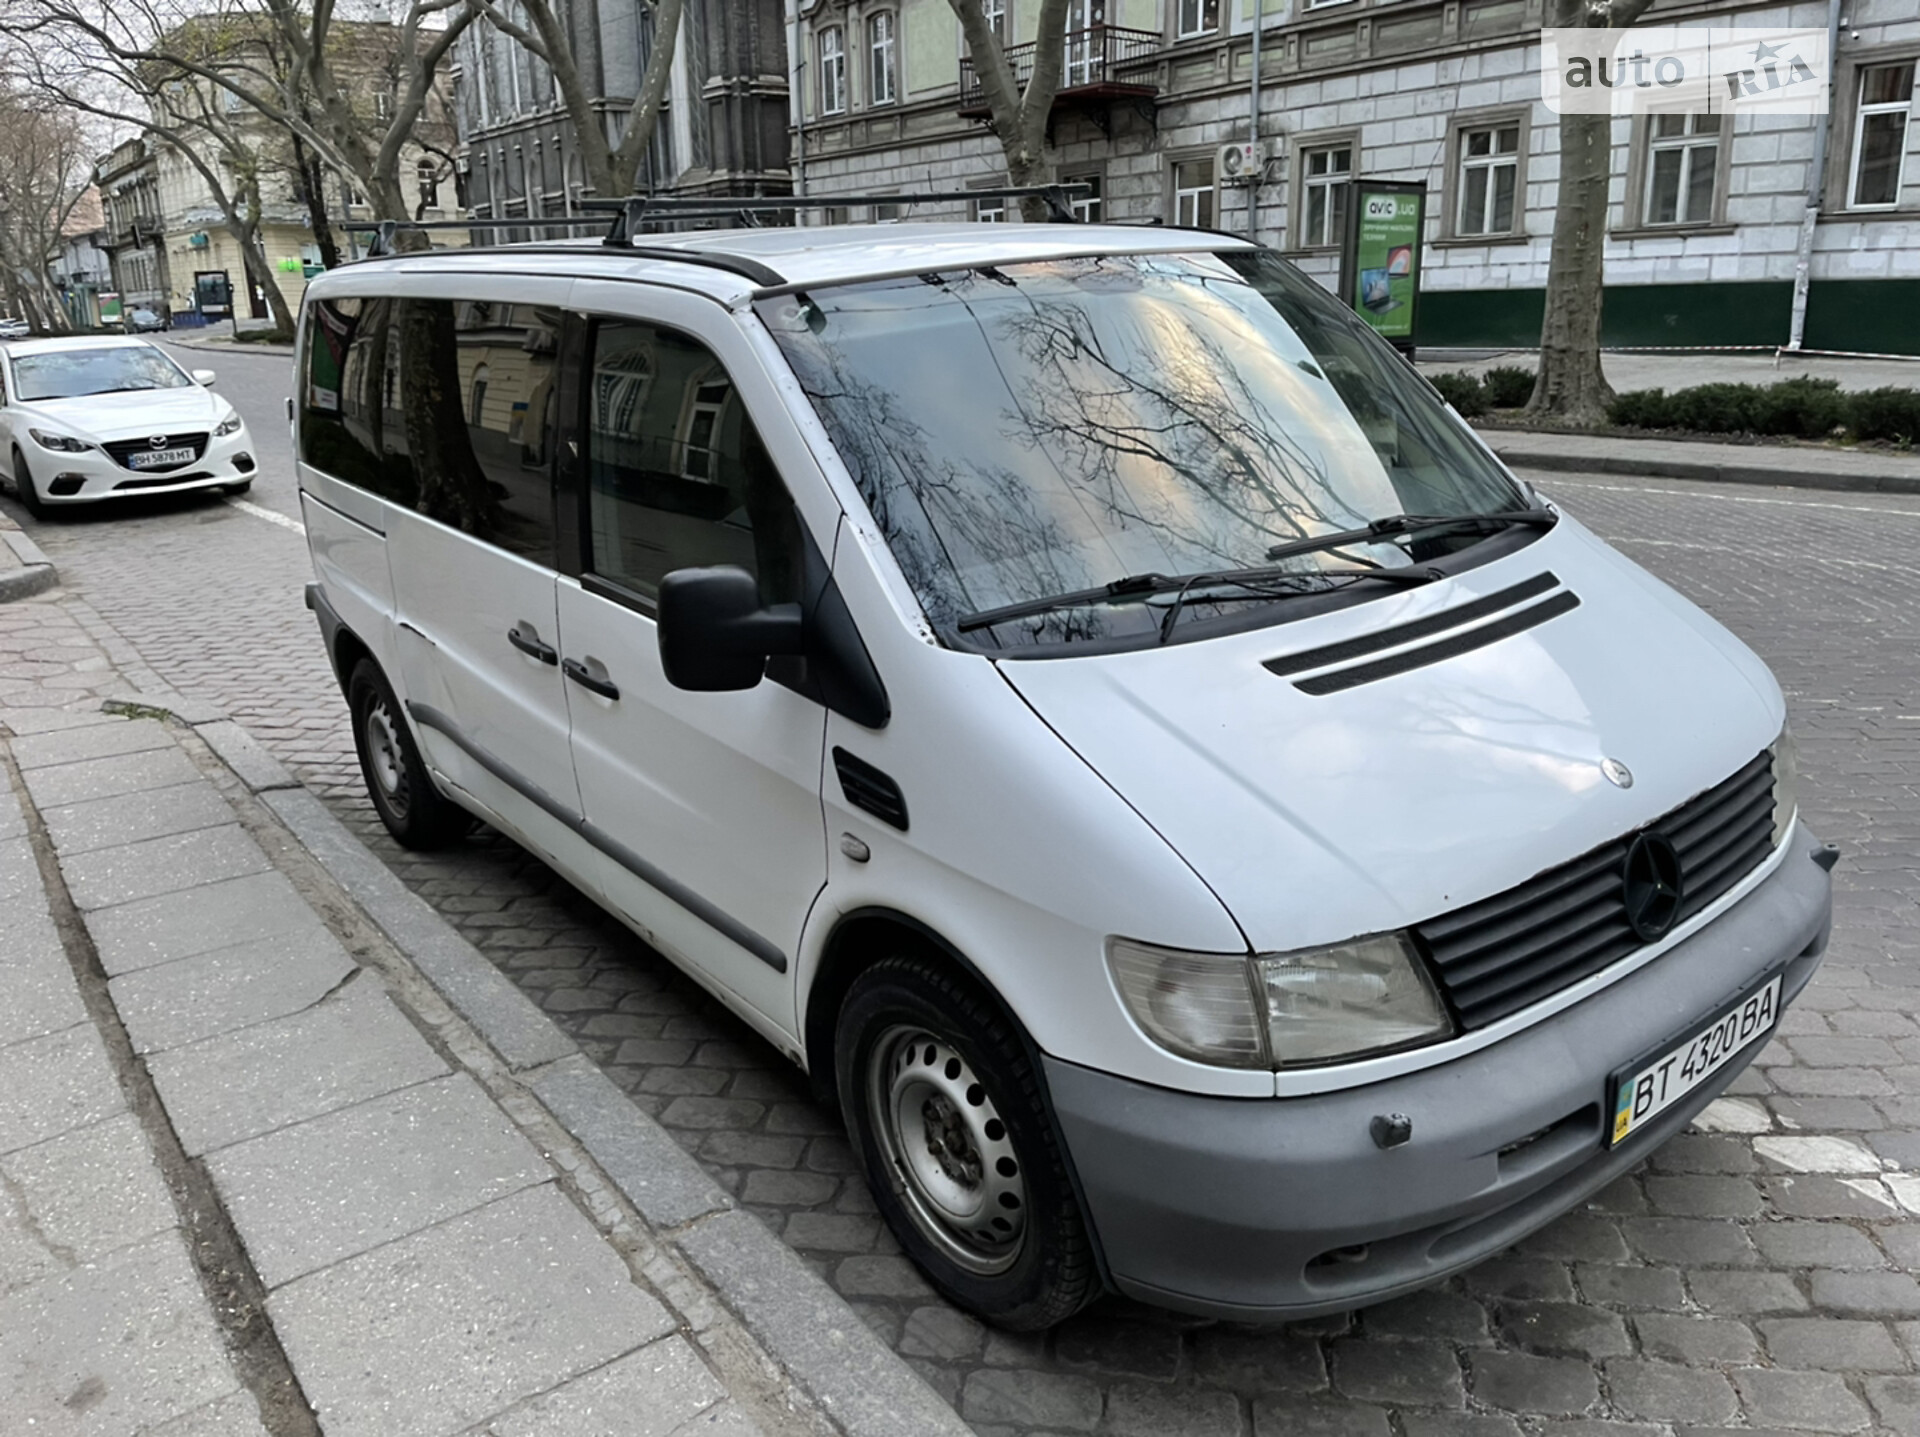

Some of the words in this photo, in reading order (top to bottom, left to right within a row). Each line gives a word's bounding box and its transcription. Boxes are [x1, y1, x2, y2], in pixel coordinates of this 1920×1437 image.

[1633, 1056, 1677, 1121] BT
[1680, 1012, 1738, 1082] 4320
[1739, 985, 1773, 1042] BA
